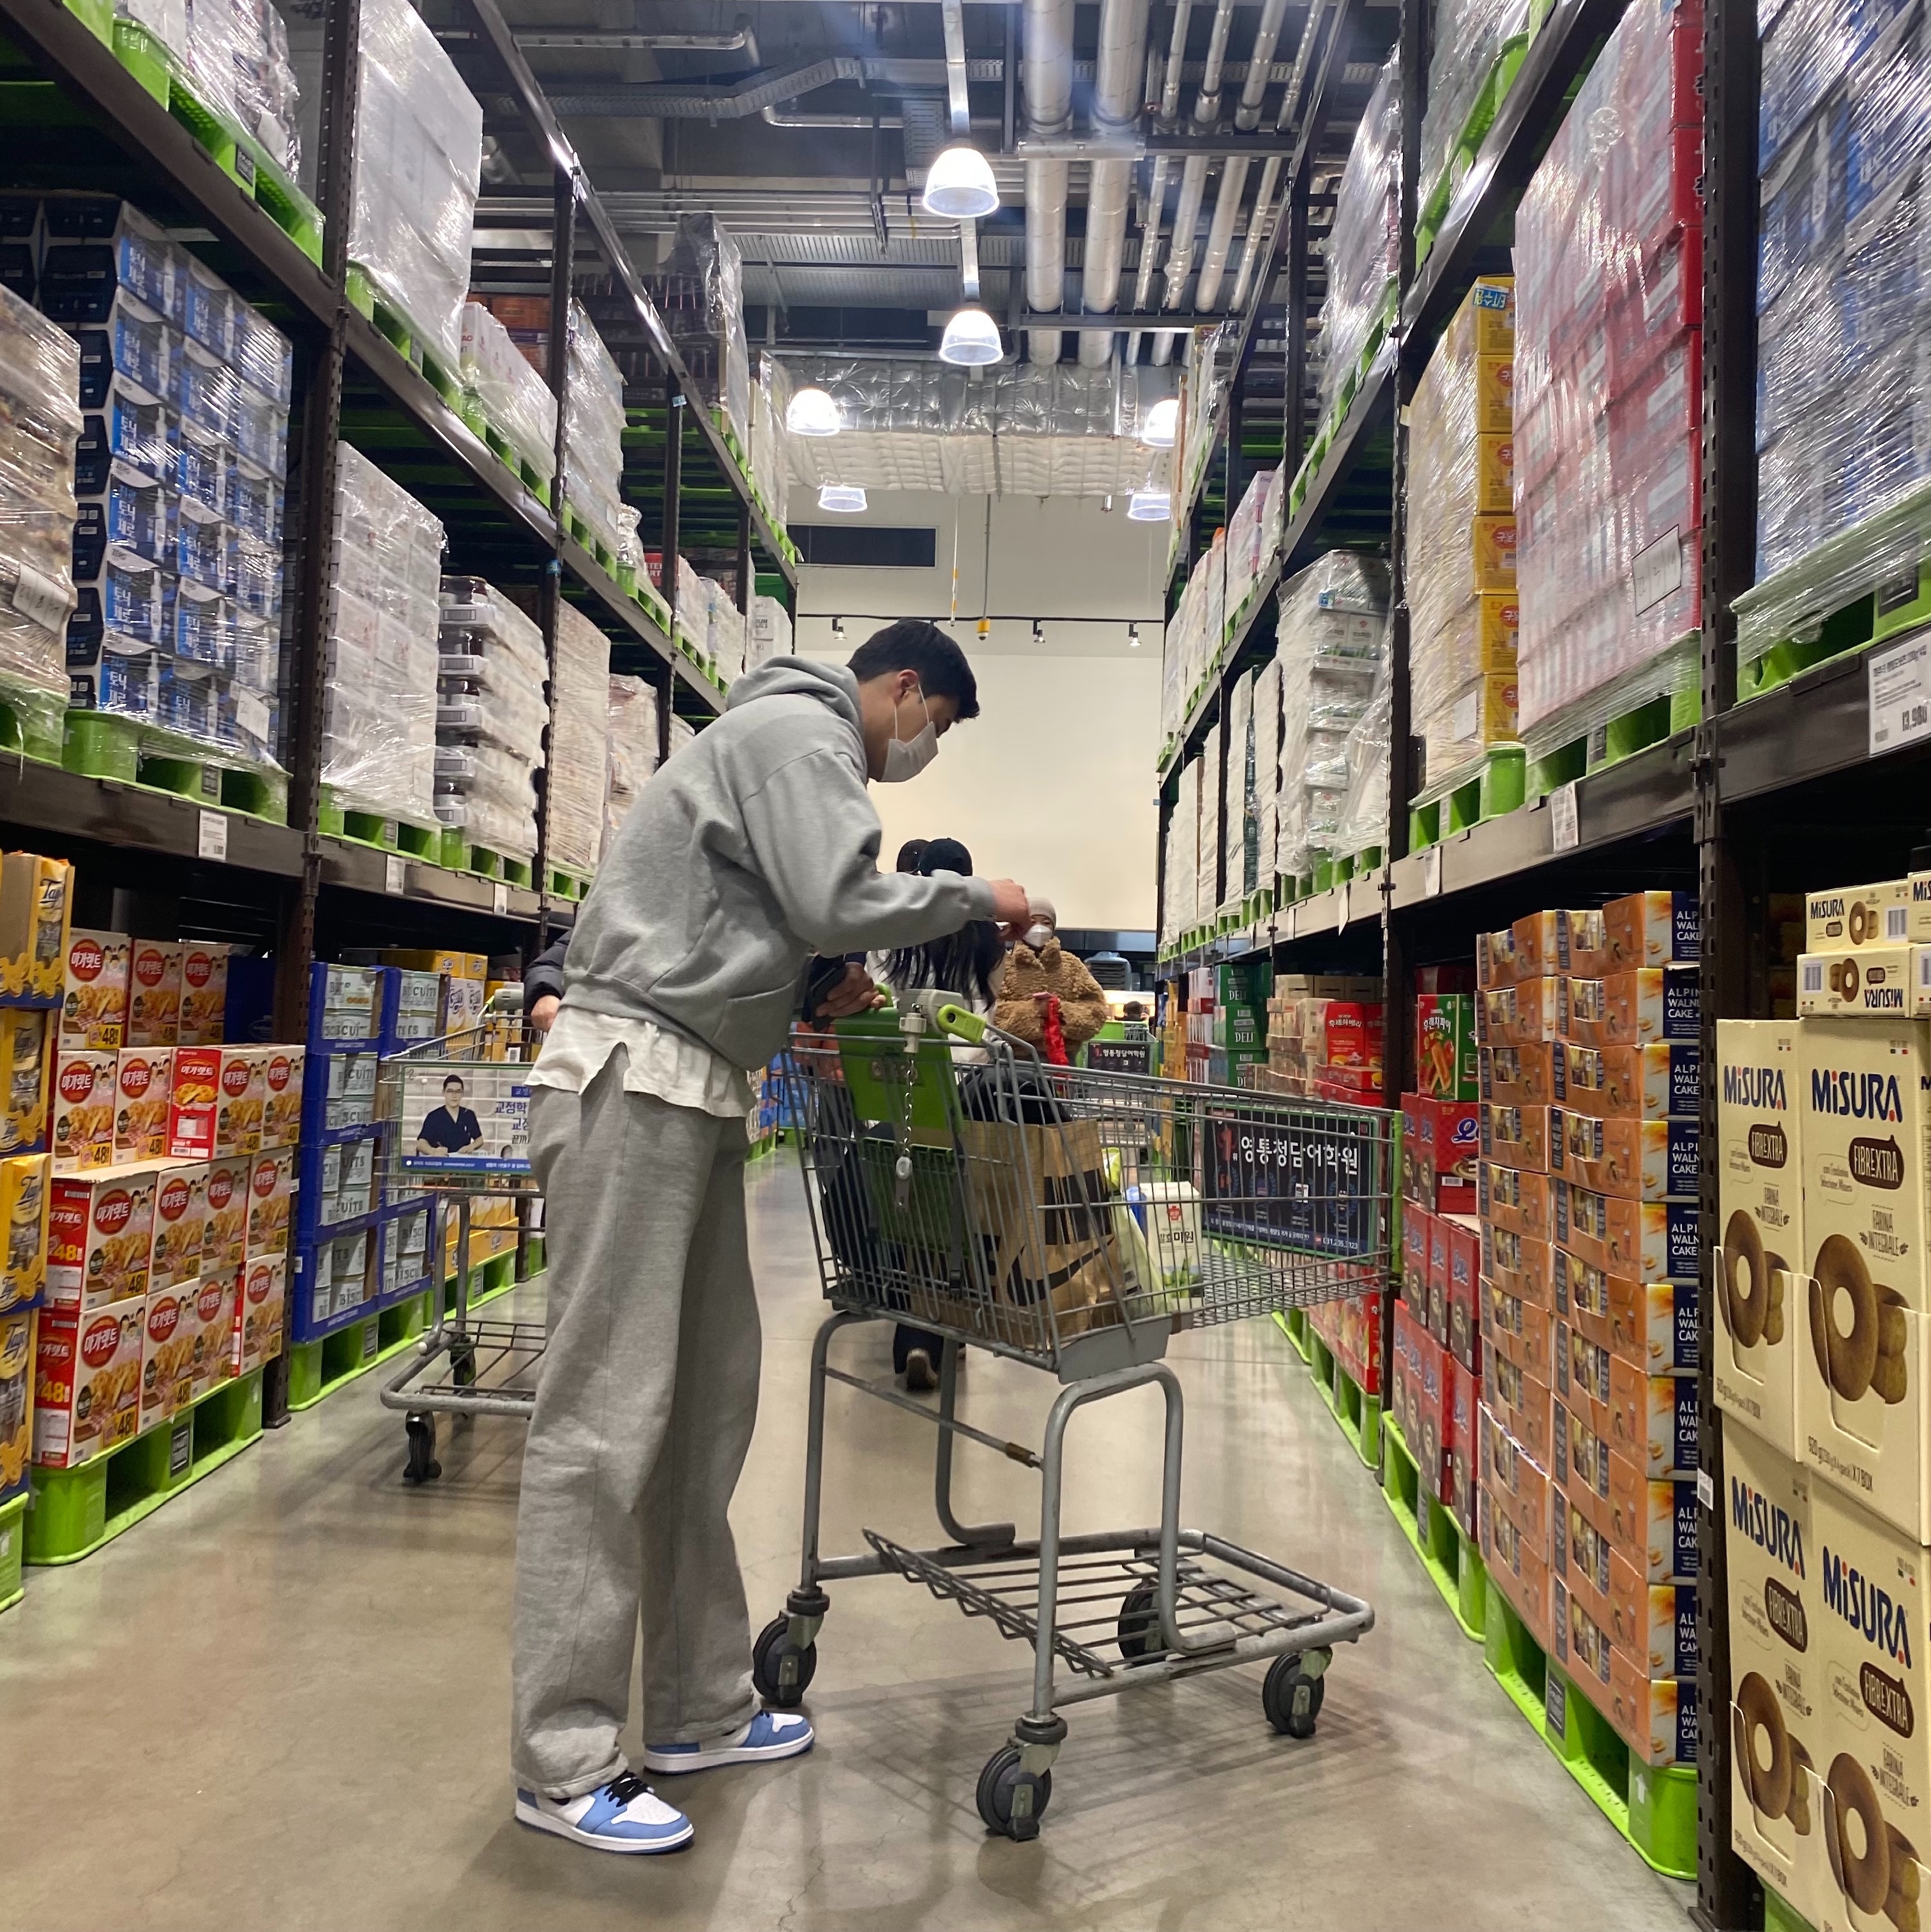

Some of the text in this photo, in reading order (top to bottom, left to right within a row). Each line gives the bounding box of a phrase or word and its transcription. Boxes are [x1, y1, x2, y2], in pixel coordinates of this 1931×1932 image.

[109, 671, 127, 690] 토닉
[71, 952, 102, 968] 마가렛트
[1668, 1009, 1694, 1018] CAKE
[102, 1028, 116, 1046] 48
[1235, 1031, 1254, 1043] DELI
[1103, 1049, 1146, 1058] 영통청담어학원
[181, 1065, 213, 1076] 마가렛트
[61, 1074, 92, 1091] 마가렛트
[1674, 1085, 1700, 1095] CAKE
[1752, 1131, 1783, 1161] FIBREXTRA
[1241, 1136, 1358, 1176] 영통청담어학원
[1854, 1145, 1898, 1182] FIBREXTRA
[1672, 1164, 1698, 1174] CAKE
[96, 1202, 130, 1222] 마가렛트
[53, 1244, 77, 1261] 48
[1672, 1245, 1698, 1256] CAKE
[84, 1328, 118, 1355] 마가렛트
[41, 1381, 64, 1403] 48
[1865, 1670, 1909, 1731] FIBREXTRA
